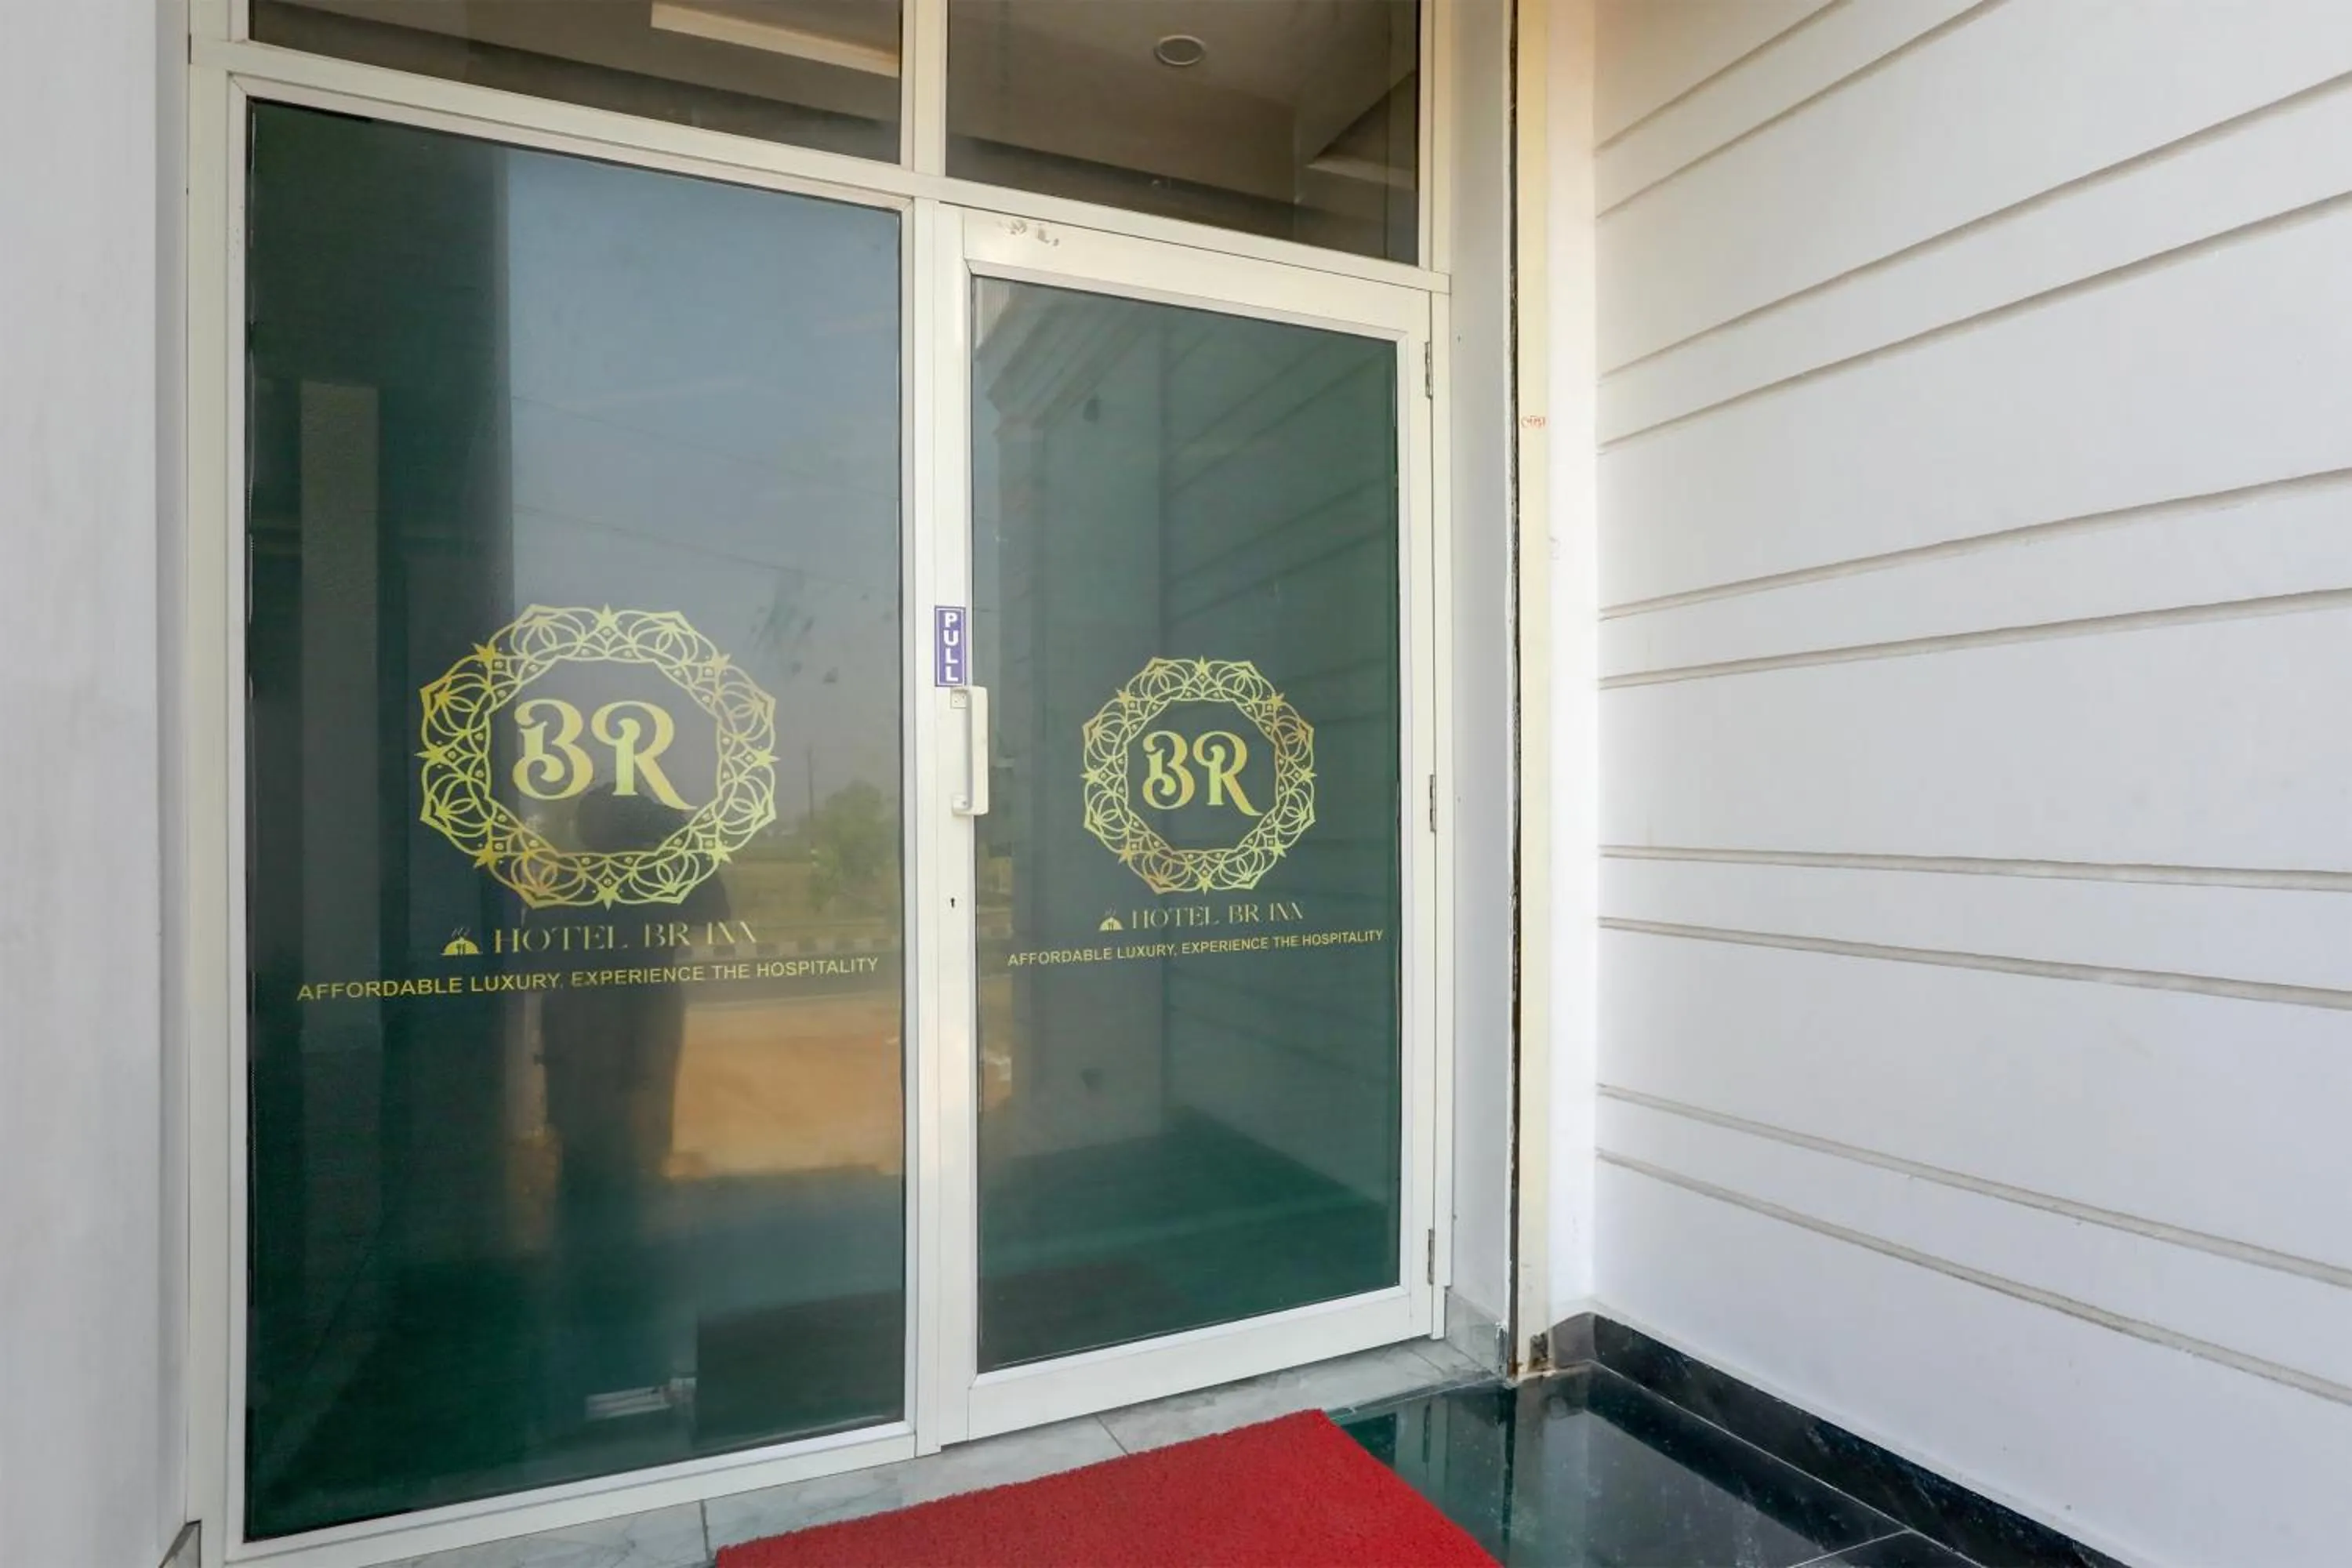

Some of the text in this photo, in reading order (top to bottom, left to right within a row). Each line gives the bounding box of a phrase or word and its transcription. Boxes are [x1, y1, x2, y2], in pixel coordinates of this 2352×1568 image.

[943, 612, 959, 682] PULL
[512, 699, 698, 811] BR
[1142, 730, 1263, 817] BR
[494, 920, 757, 955] HOTEL BR INN
[1132, 902, 1303, 930] HOTEL BR INN
[1007, 947, 1112, 967] AFFORDABLE
[1181, 937, 1268, 954] EXPERIENCE
[1274, 935, 1301, 949] THE
[1302, 929, 1385, 946] HOSPITALITY
[297, 977, 463, 1001] AFFORDABLE
[572, 965, 705, 988] EXPERIENCE
[712, 964, 750, 980] THE
[757, 956, 879, 978] HOSPITALITY
